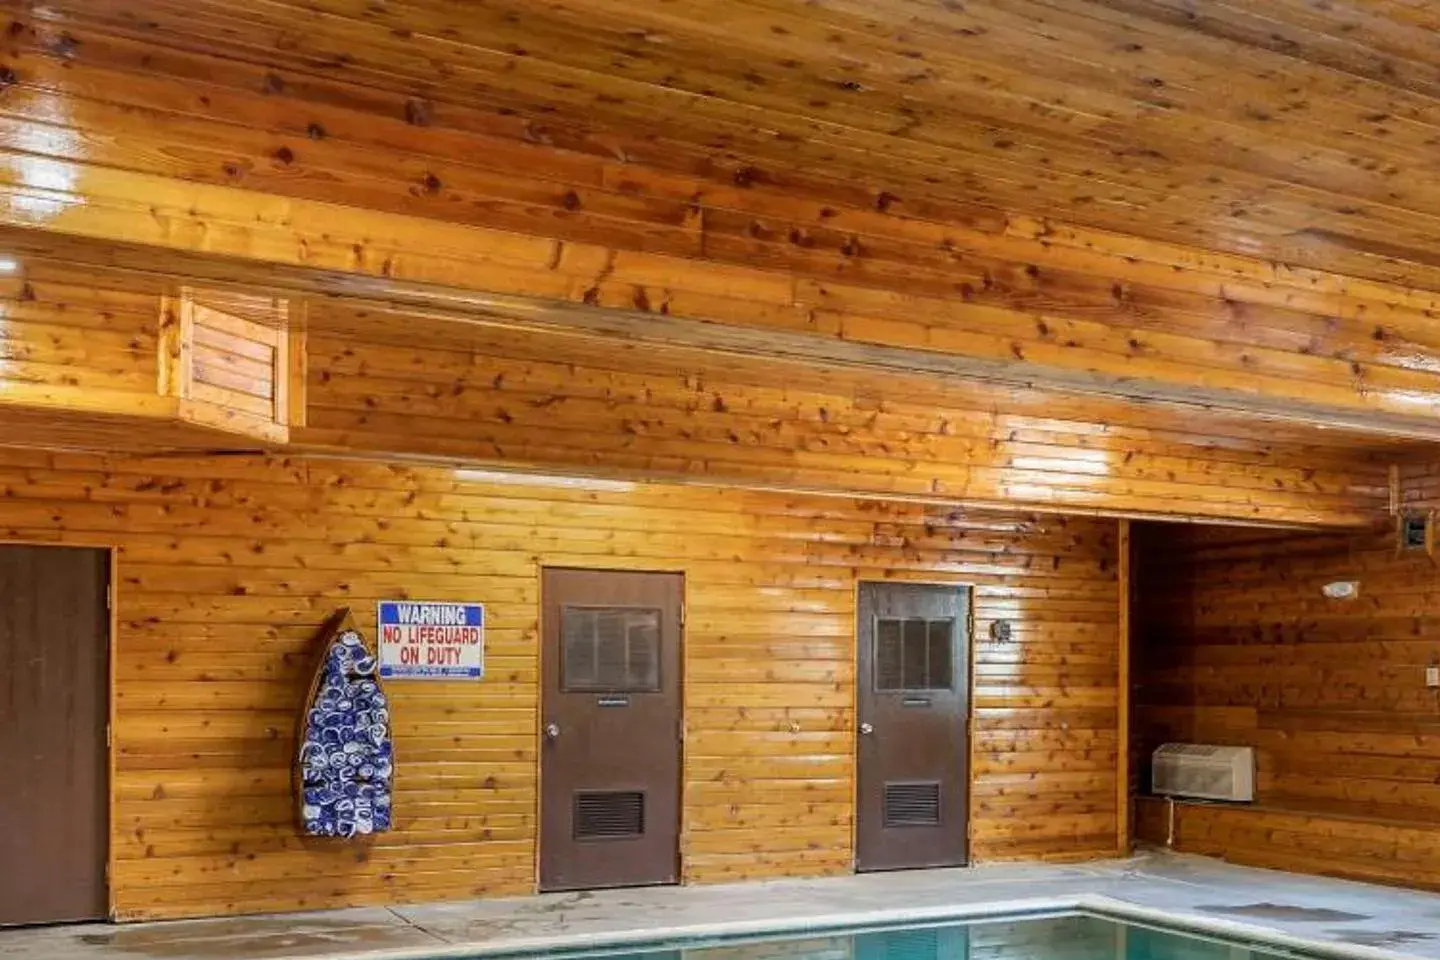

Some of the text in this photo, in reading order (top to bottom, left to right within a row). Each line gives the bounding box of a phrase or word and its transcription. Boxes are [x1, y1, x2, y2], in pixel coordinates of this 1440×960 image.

[397, 604, 466, 625] WARNING
[383, 627, 478, 644] NO LIFEGUARD
[400, 647, 461, 665] ON DUTY
